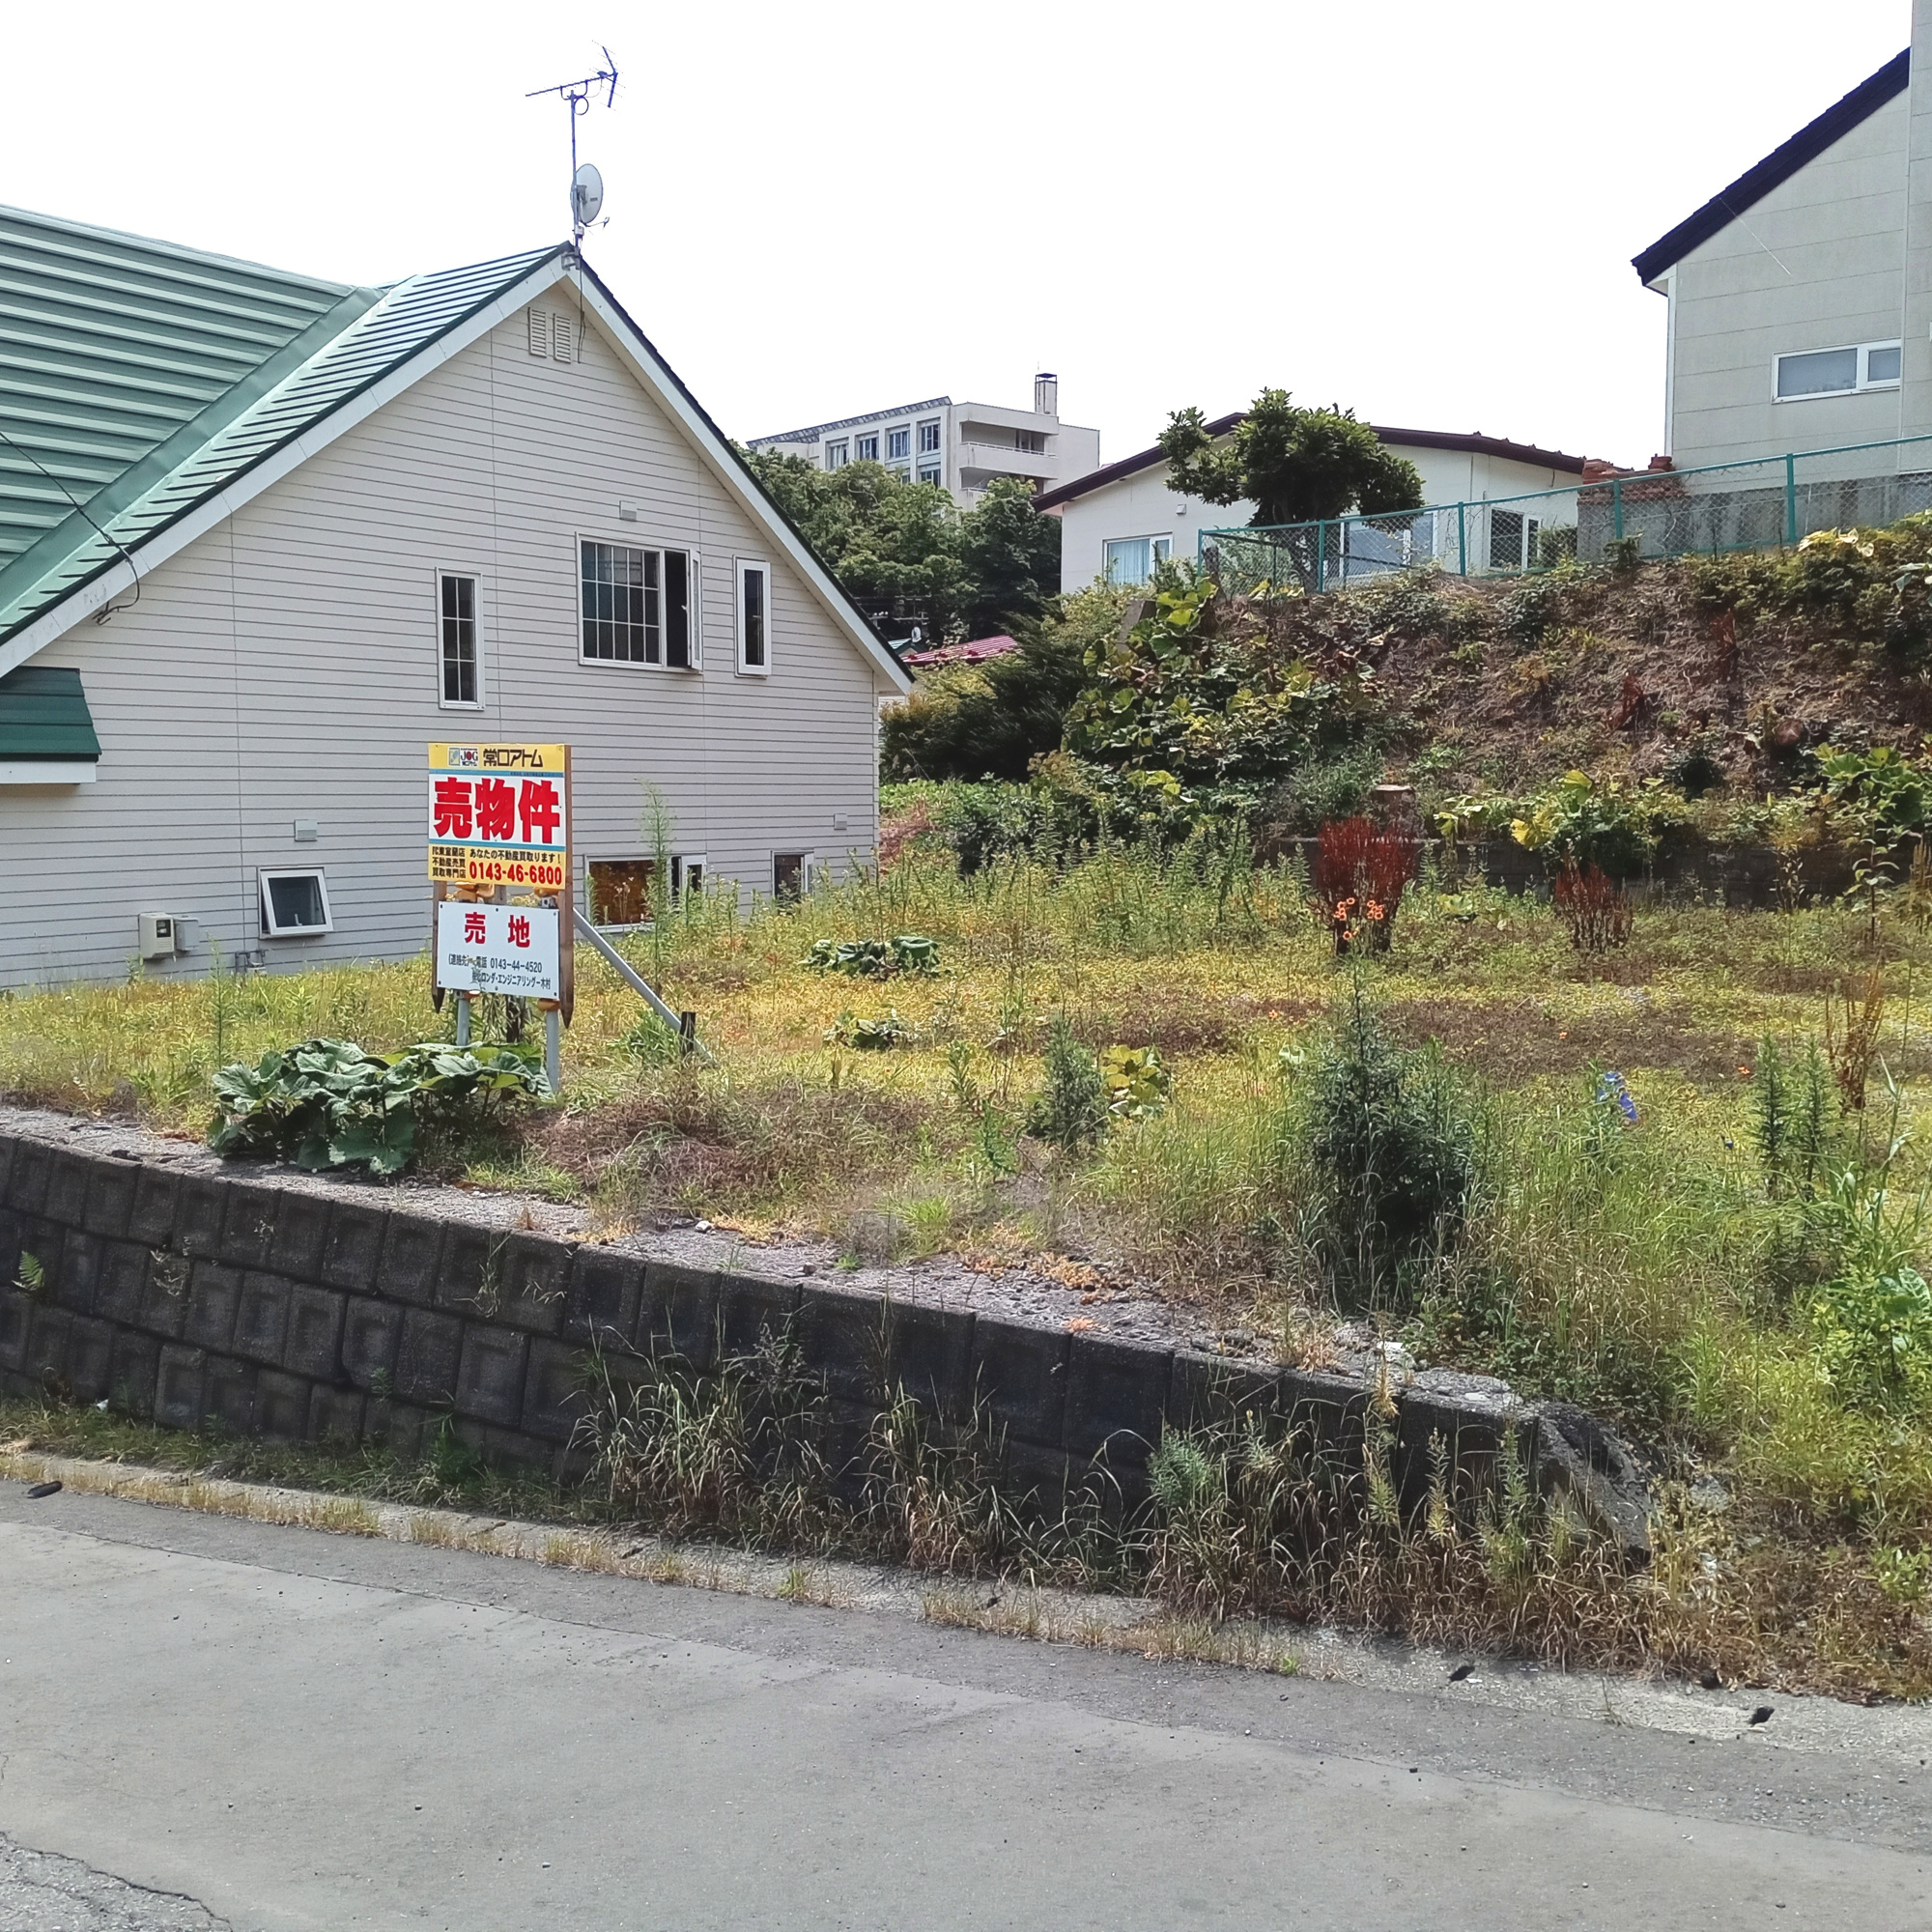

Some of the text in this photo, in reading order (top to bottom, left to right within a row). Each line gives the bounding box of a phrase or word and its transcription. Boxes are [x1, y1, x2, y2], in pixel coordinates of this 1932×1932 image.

[483, 748, 543, 768] 常口アトム
[434, 777, 560, 844] 売物件
[432, 857, 466, 867] 不動産売買
[469, 848, 560, 864] あなたの不動産買取ります！
[432, 867, 466, 878] 買取専門店
[469, 861, 562, 885] 0143-46-6800
[490, 957, 543, 974] 0143-44-4520
